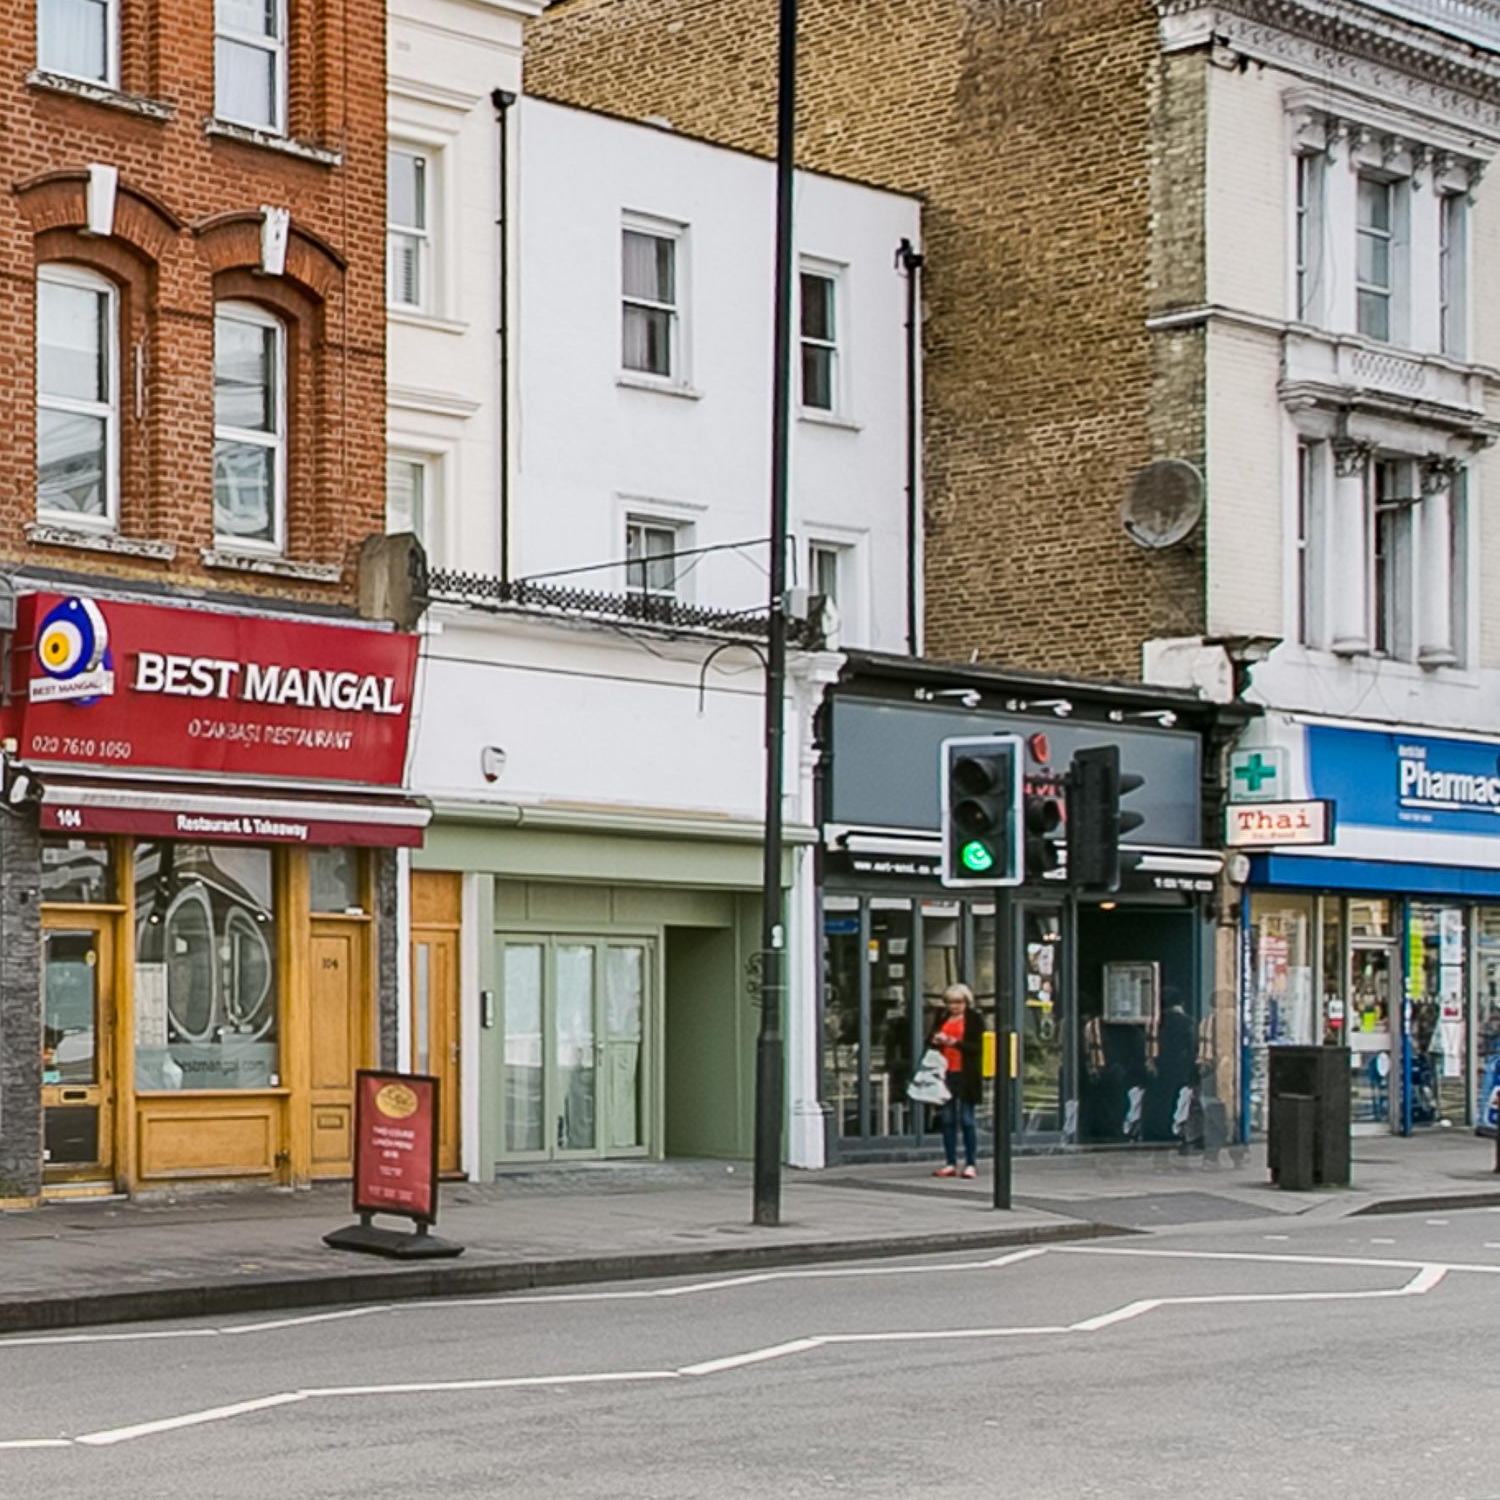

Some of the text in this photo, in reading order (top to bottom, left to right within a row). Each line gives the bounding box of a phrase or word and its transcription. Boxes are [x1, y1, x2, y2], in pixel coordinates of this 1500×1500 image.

[32, 681, 101, 696] BEST MANGAL
[135, 651, 404, 715] BEST MANGAL
[32, 734, 60, 753] 020
[99, 740, 132, 759] 1050
[264, 724, 354, 750] RESTAURANT
[56, 808, 309, 841] 104 Restaurant & Takeaway
[1237, 808, 1311, 831] Thai
